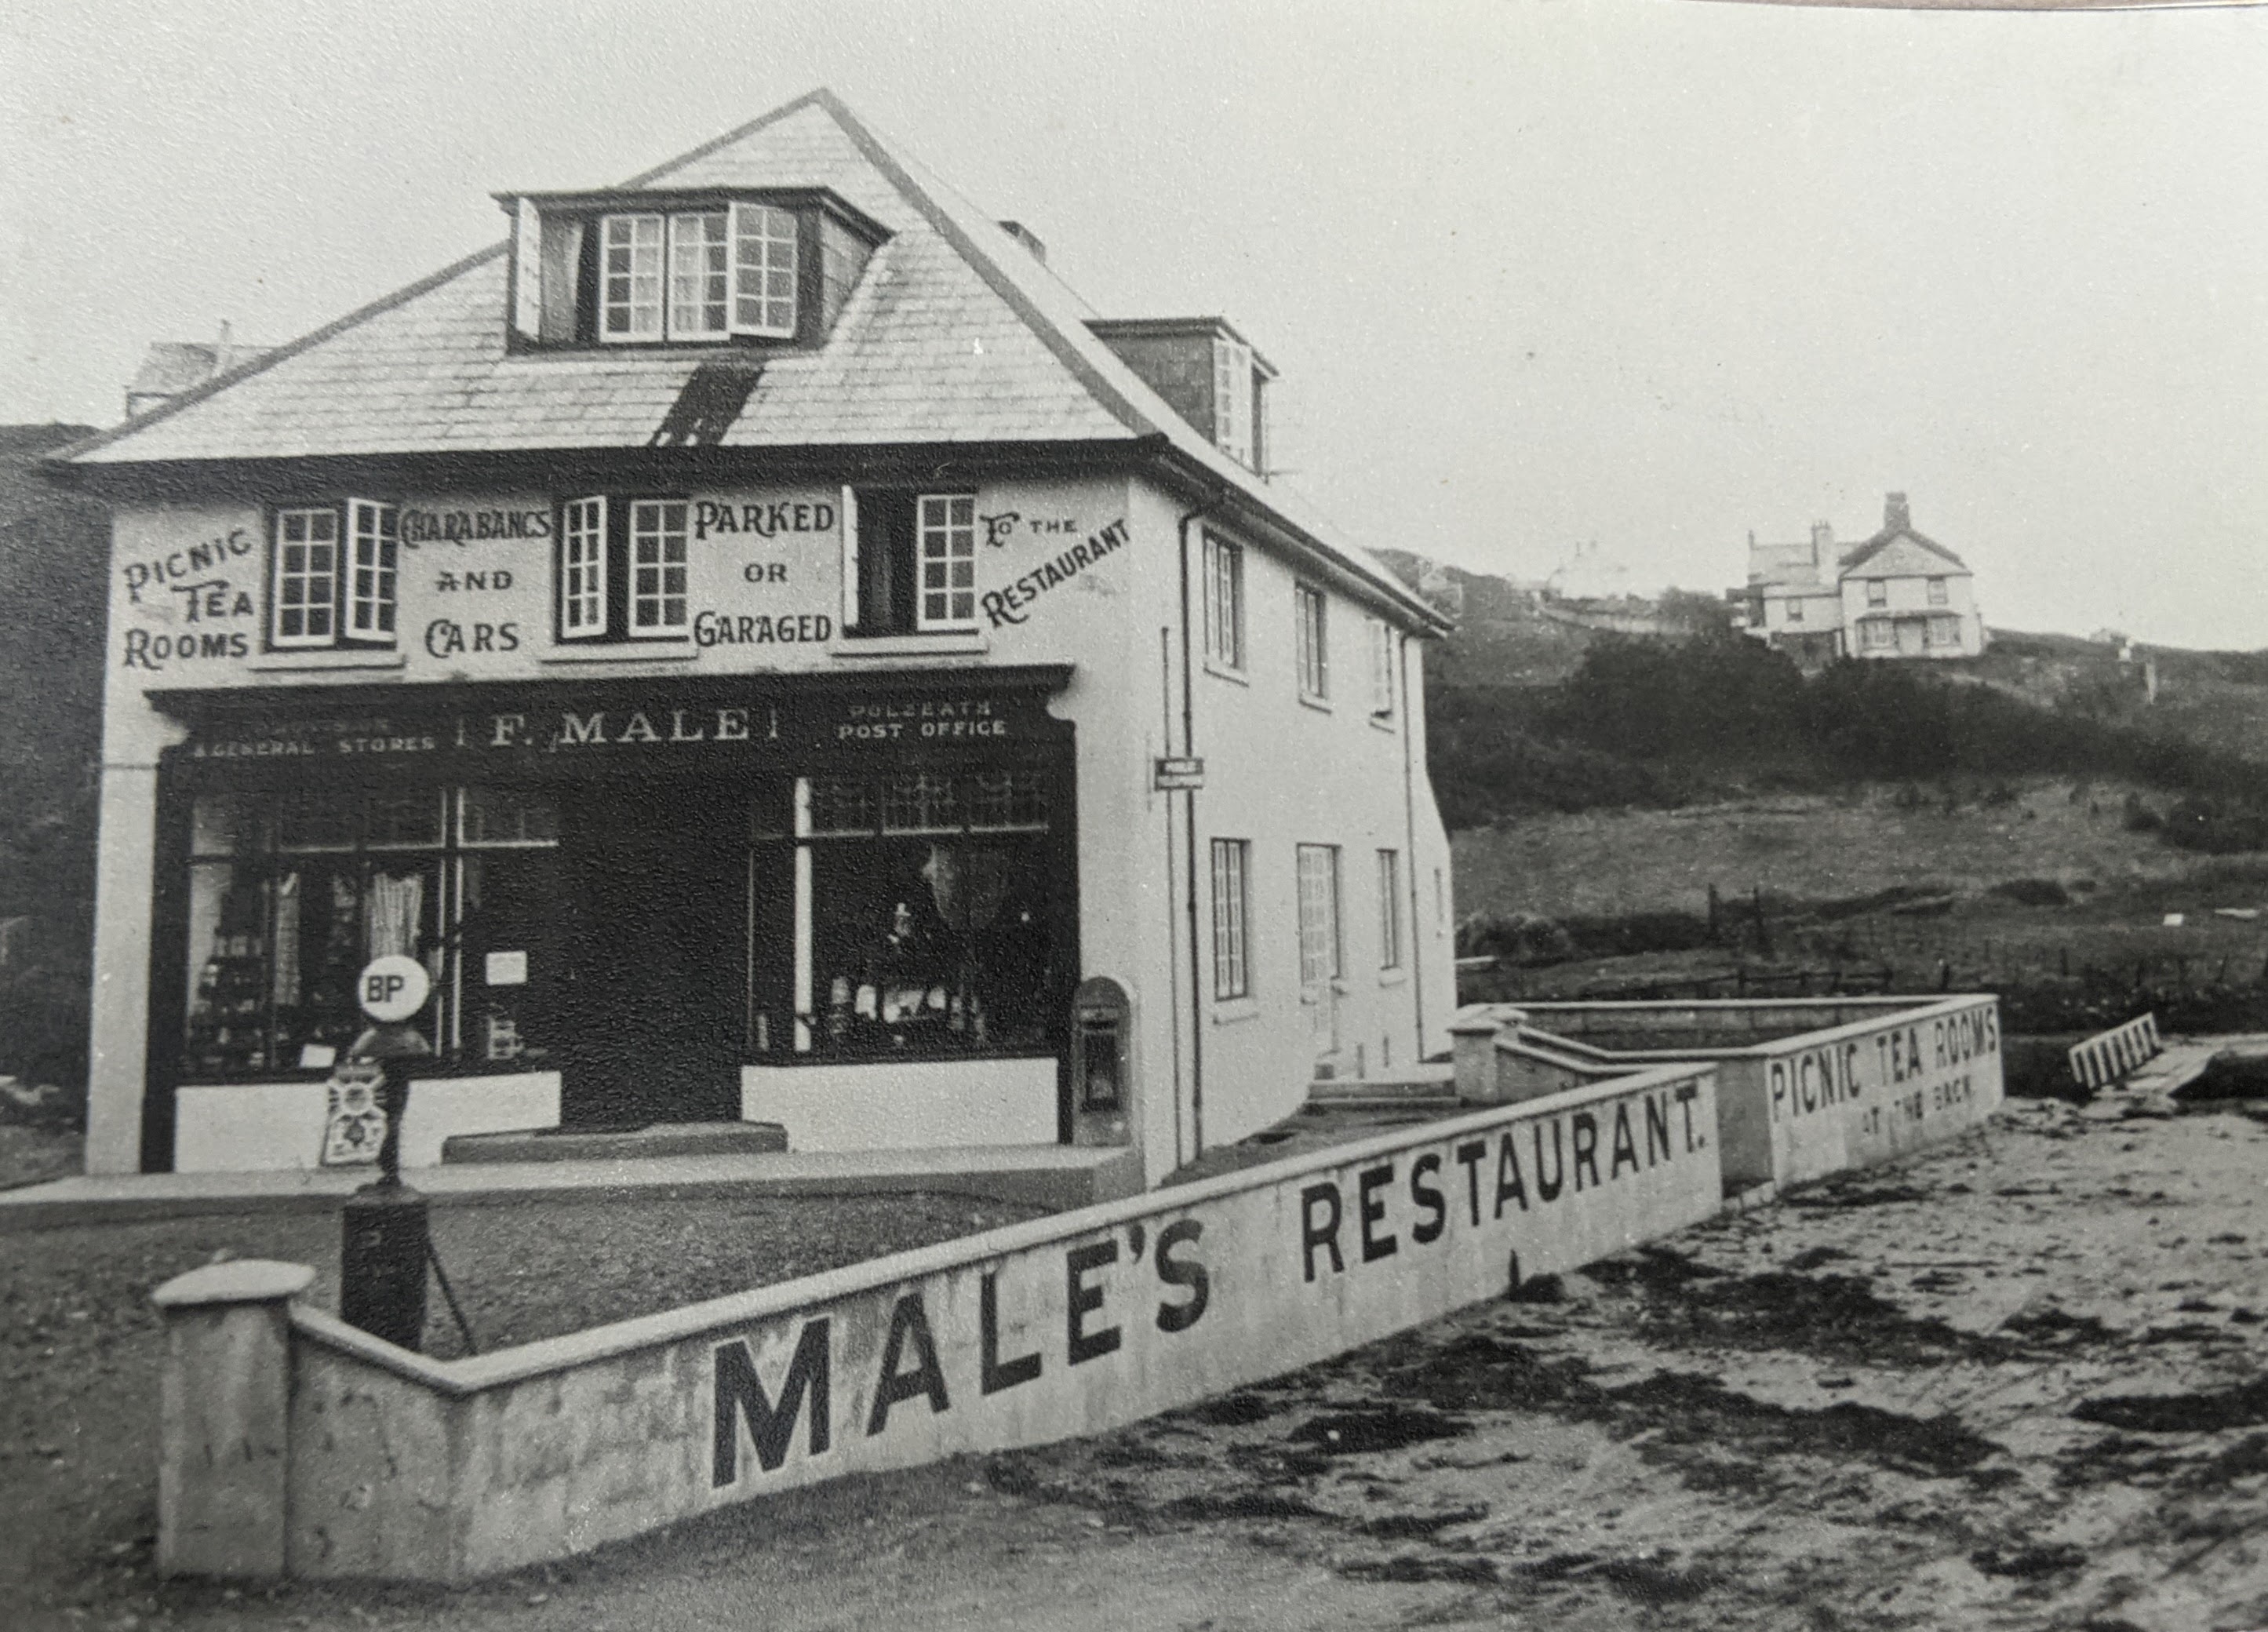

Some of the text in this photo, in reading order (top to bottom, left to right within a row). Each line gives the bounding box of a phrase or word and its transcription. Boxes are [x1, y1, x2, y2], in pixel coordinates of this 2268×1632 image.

[399, 508, 550, 549] CHARABANCS
[695, 501, 834, 539] PARKED
[1029, 517, 1077, 534] THE
[122, 528, 252, 603] PICNIC
[435, 570, 513, 592] AND
[744, 563, 787, 583] OR
[981, 518, 1131, 628] RESTAURANT
[170, 580, 254, 623] TEA
[424, 619, 519, 658] CARS
[694, 610, 831, 647] GARAGED
[122, 628, 249, 670] ROOMS
[339, 737, 435, 754] STORES
[490, 709, 749, 746] F. MALE
[838, 719, 1007, 740] POST OFFICE
[366, 974, 404, 1003] BP
[1771, 1007, 1996, 1123] PICNIC TEA ROOMS
[712, 1219, 1210, 1488] MALE'S
